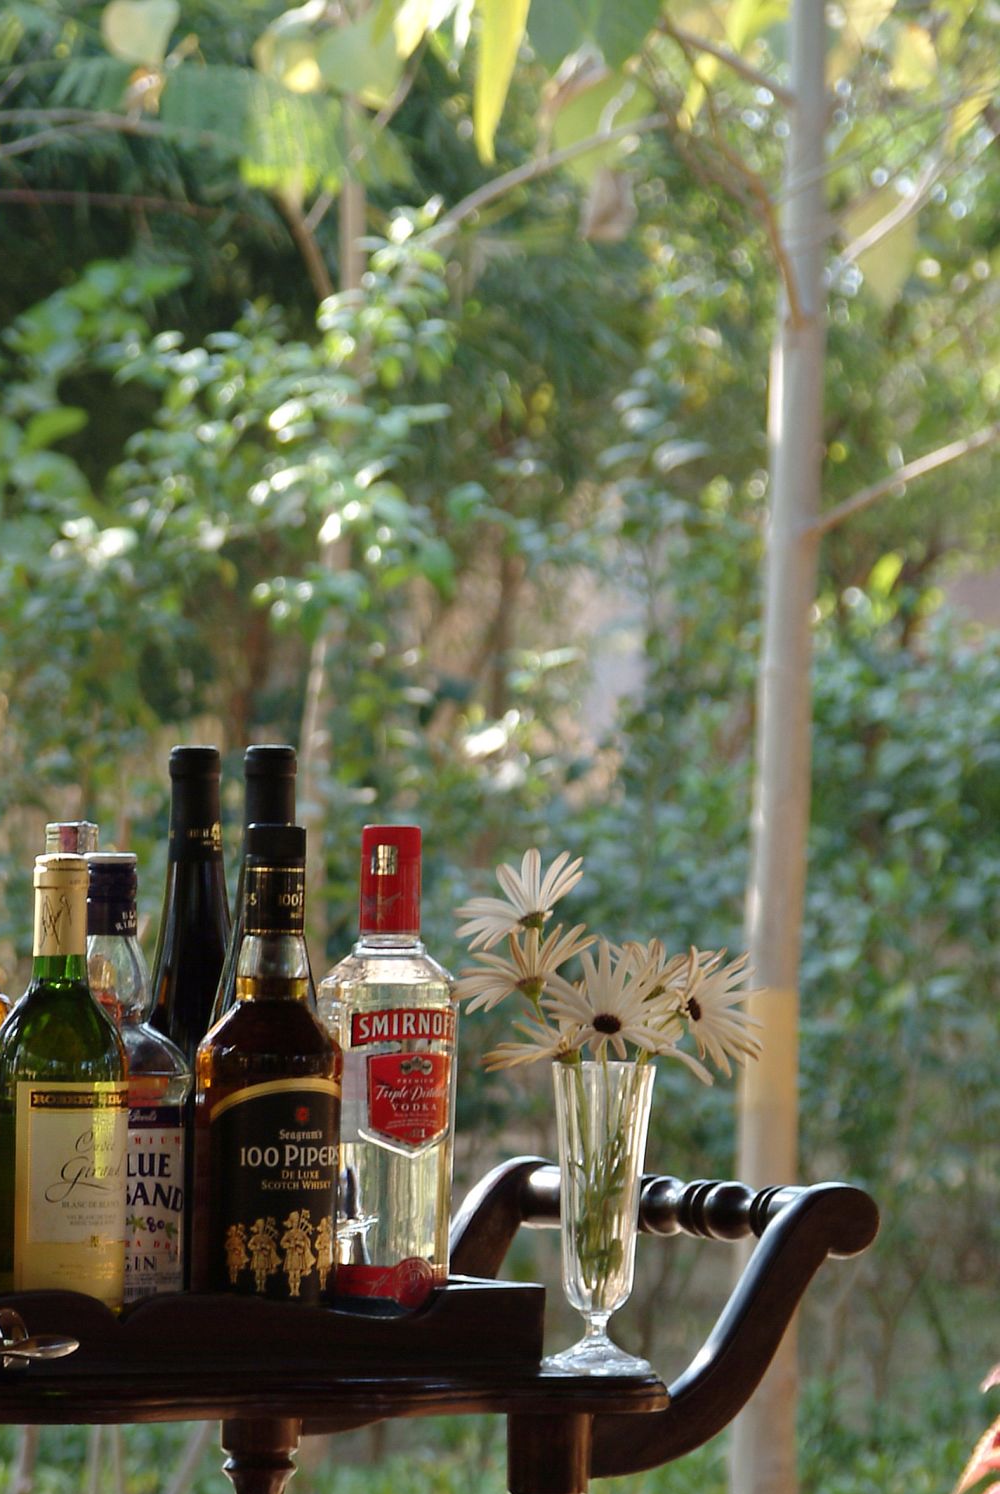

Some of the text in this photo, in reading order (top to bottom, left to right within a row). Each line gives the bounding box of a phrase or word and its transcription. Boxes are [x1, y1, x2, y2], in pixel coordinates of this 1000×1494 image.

[391, 1103, 438, 1112] VODKA
[279, 1129, 323, 1142] Seagram's
[240, 1144, 340, 1167] 100 PIPERS
[127, 1153, 171, 1178] LUE
[298, 1169, 320, 1179] LUXE
[261, 1180, 331, 1190] SCOTCH WHISKY
